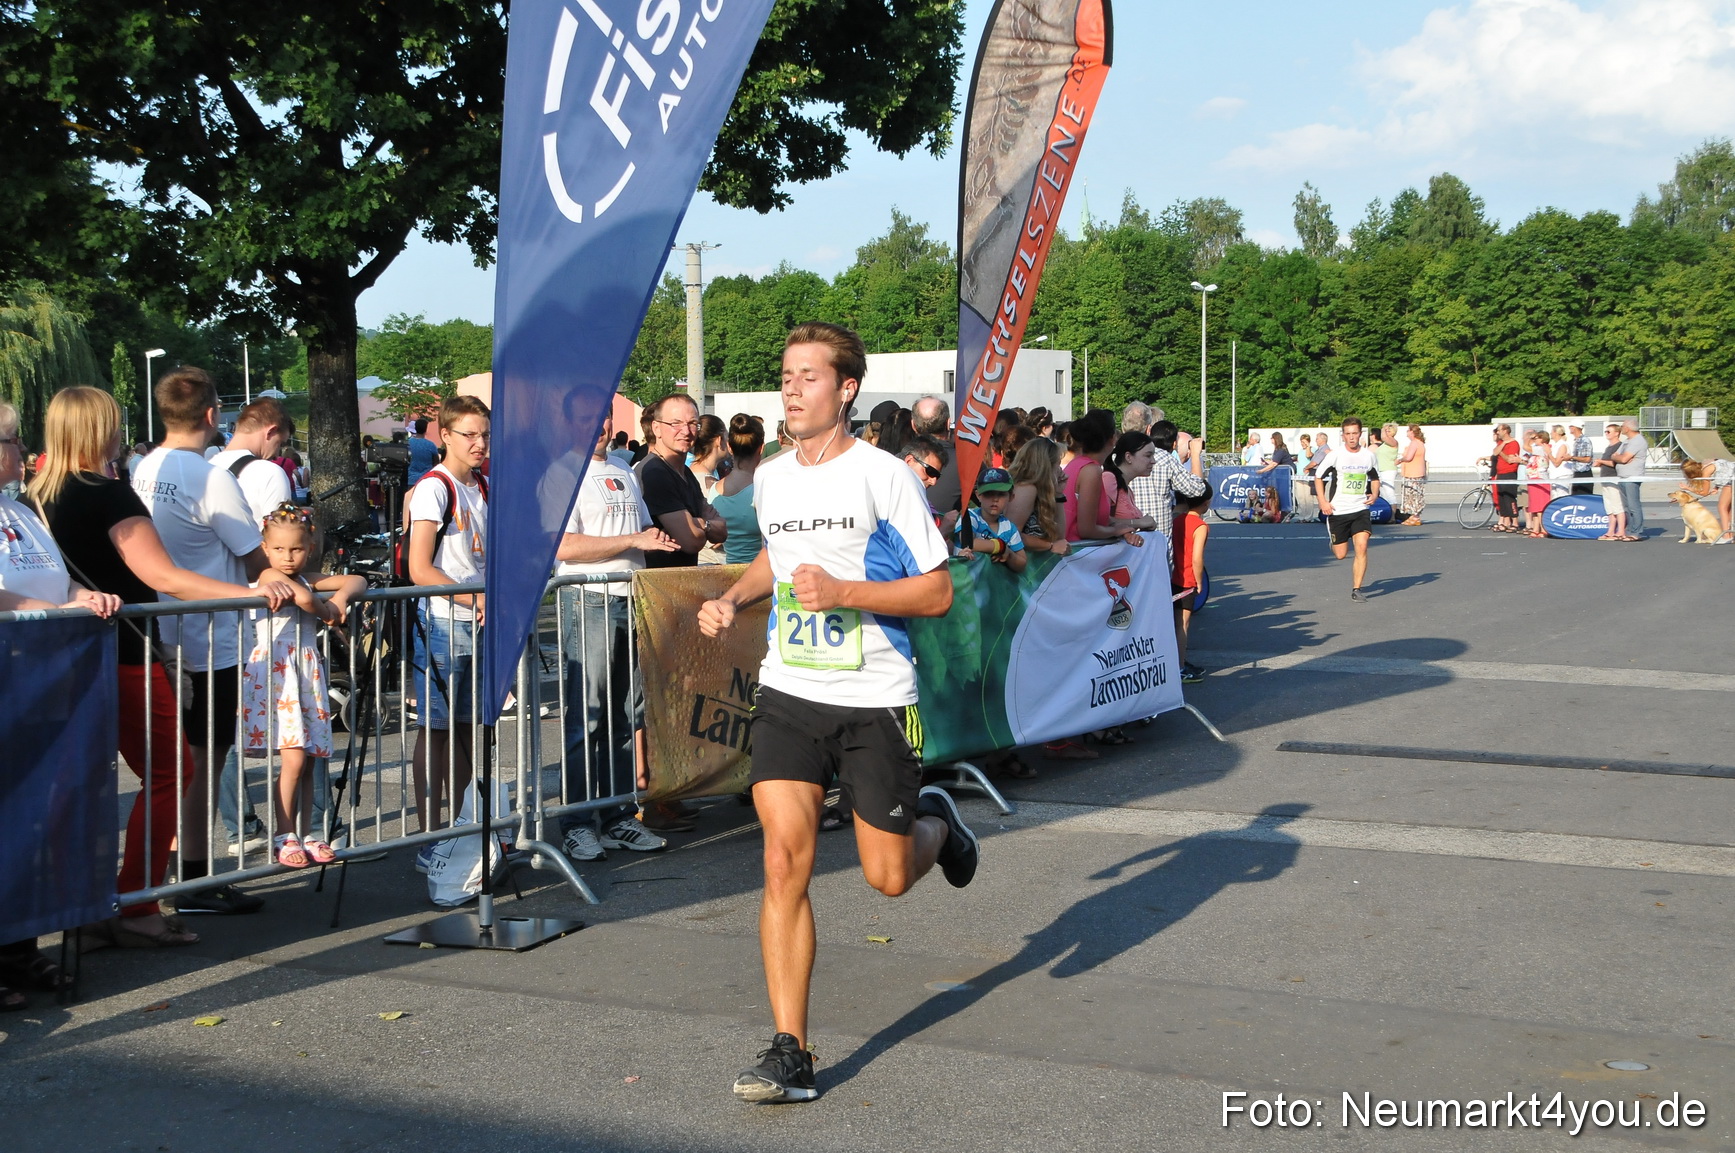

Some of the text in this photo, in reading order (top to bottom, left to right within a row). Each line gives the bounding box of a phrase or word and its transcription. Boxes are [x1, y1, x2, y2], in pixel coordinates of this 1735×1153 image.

[130, 478, 178, 497] OLGER
[1346, 480, 1363, 490] 205
[768, 516, 855, 536] DELPHI
[786, 612, 845, 647] 216
[1110, 613, 1129, 626] 1628
[1092, 636, 1155, 671] Neumarkter
[1090, 658, 1167, 709] Lammsbräu
